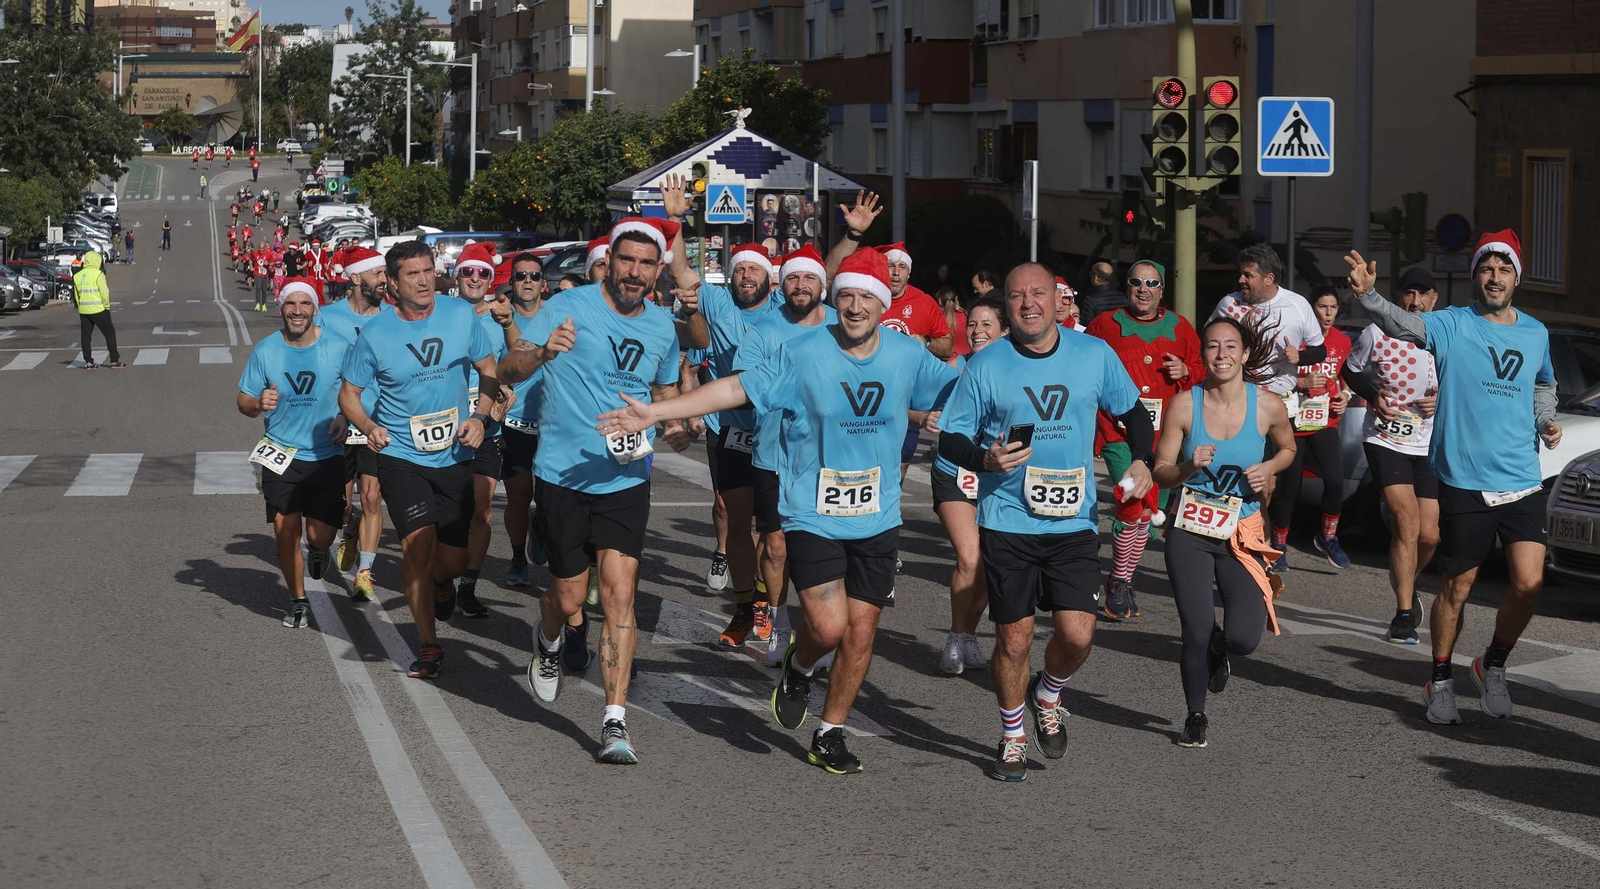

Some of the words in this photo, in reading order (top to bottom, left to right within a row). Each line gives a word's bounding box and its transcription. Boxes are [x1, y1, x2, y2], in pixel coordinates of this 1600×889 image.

[171, 146, 181, 155] LA
[410, 367, 451, 379] VANGUARDIA
[417, 374, 445, 383] NATURAL
[603, 371, 643, 384] VANGUARDIA
[607, 379, 635, 389] NATURAL
[1481, 381, 1522, 393] VANGUARDIA
[1487, 388, 1515, 399] NATURAL
[1299, 409, 1324, 420] 185
[839, 420, 887, 428] VANGUARDIA
[417, 422, 454, 443] 107
[1034, 433, 1067, 442] NATURAL
[612, 431, 643, 454] 350
[256, 444, 287, 466] 478
[824, 485, 873, 505] 216
[1030, 485, 1080, 505] 333
[1182, 502, 1230, 528] 297
